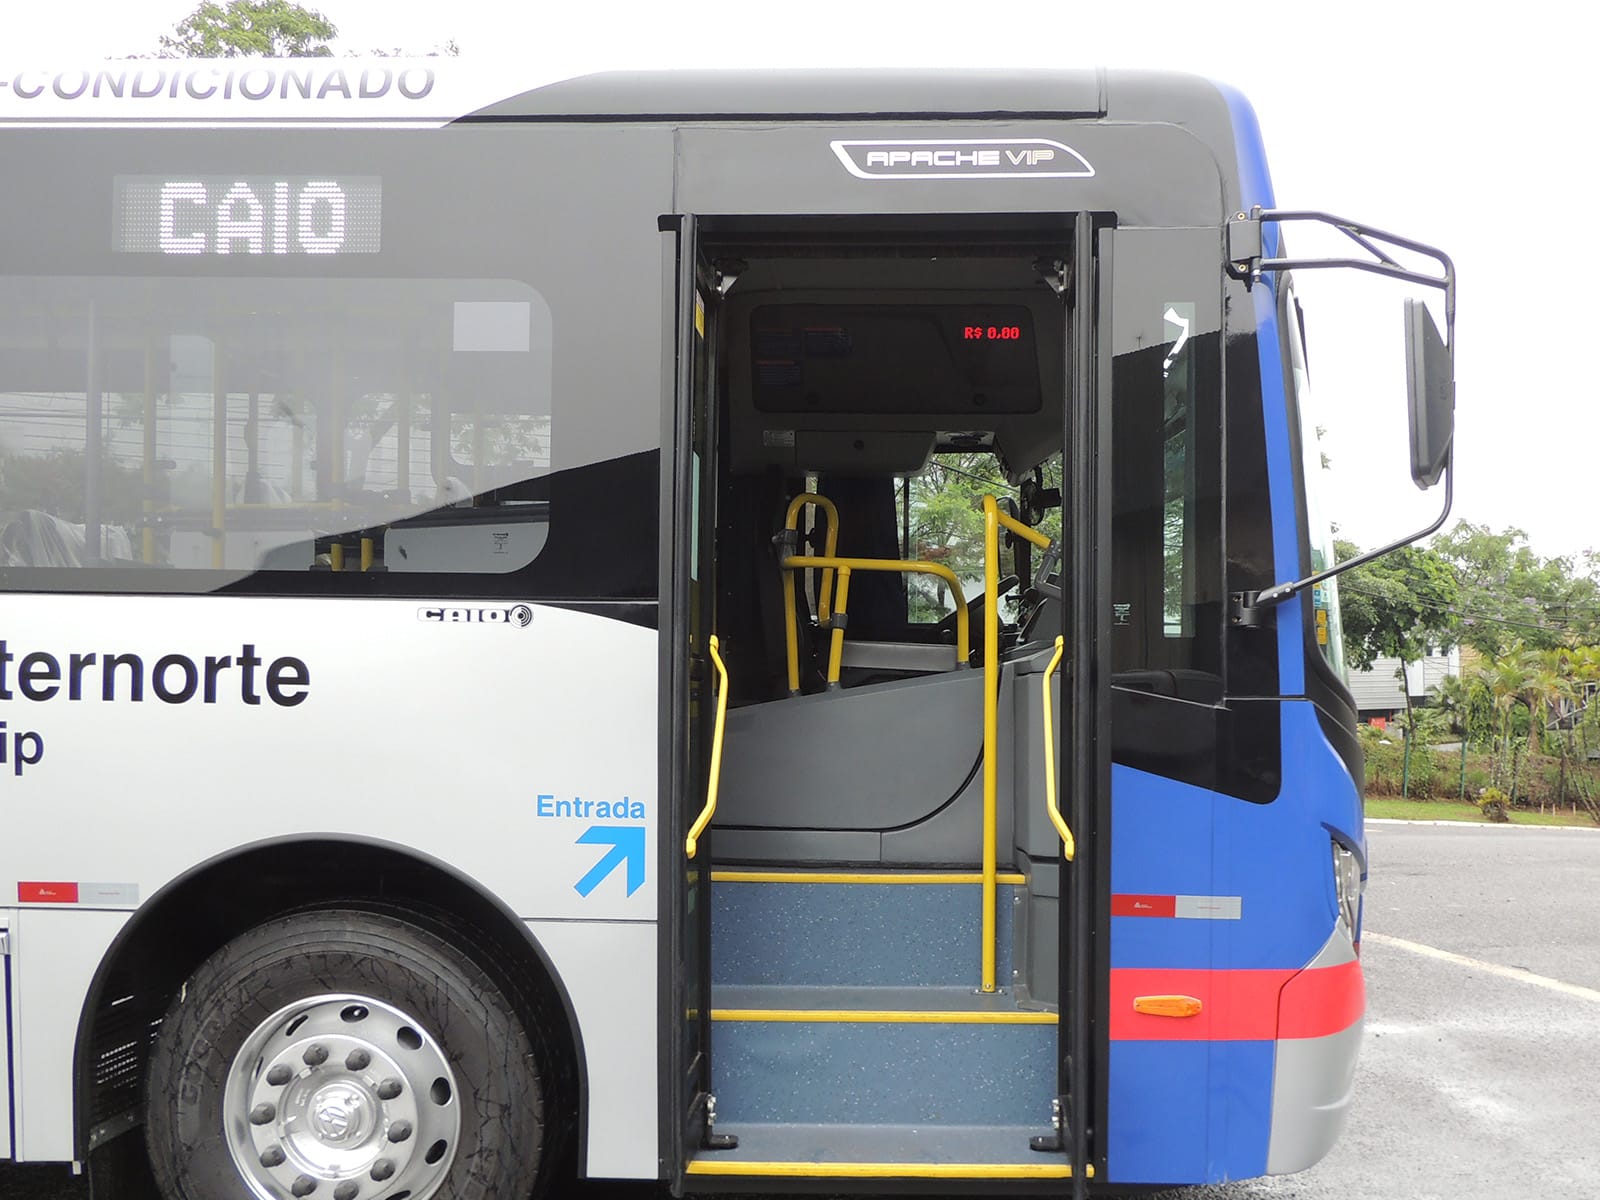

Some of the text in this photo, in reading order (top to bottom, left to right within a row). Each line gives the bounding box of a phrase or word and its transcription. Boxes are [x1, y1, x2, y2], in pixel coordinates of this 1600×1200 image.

[866, 150, 1055, 167] APACHE VIP
[159, 181, 346, 255] CAIO
[964, 326, 983, 340] R$
[417, 607, 509, 623] CAIO
[536, 794, 646, 819] Entrada
